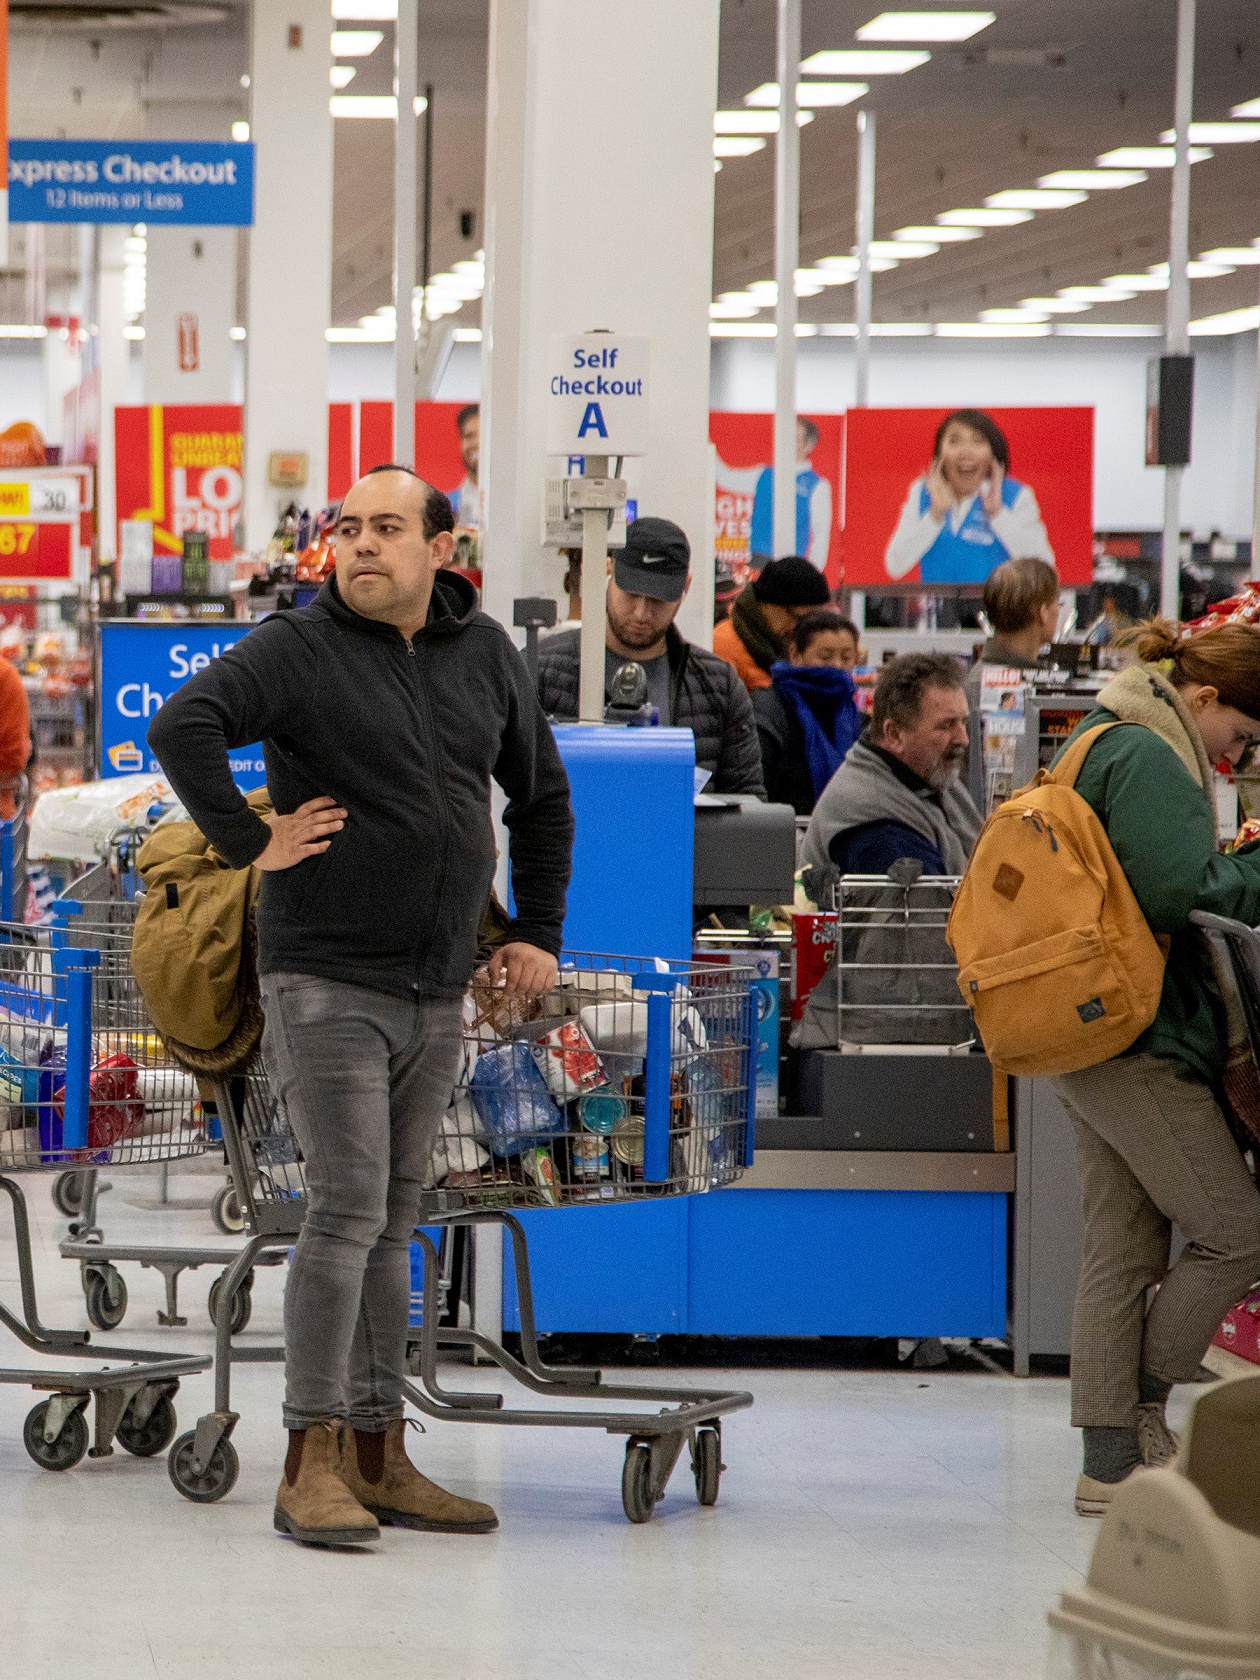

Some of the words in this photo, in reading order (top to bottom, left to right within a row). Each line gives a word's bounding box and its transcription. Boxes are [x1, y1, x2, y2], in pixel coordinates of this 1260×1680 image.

[102, 154, 237, 185] Checkout
[45, 188, 67, 208] 12
[68, 188, 120, 209] Items
[121, 192, 141, 209] or
[143, 188, 184, 210] Less
[573, 348, 618, 369] Self
[551, 375, 642, 396] Checkout
[577, 401, 609, 438] A
